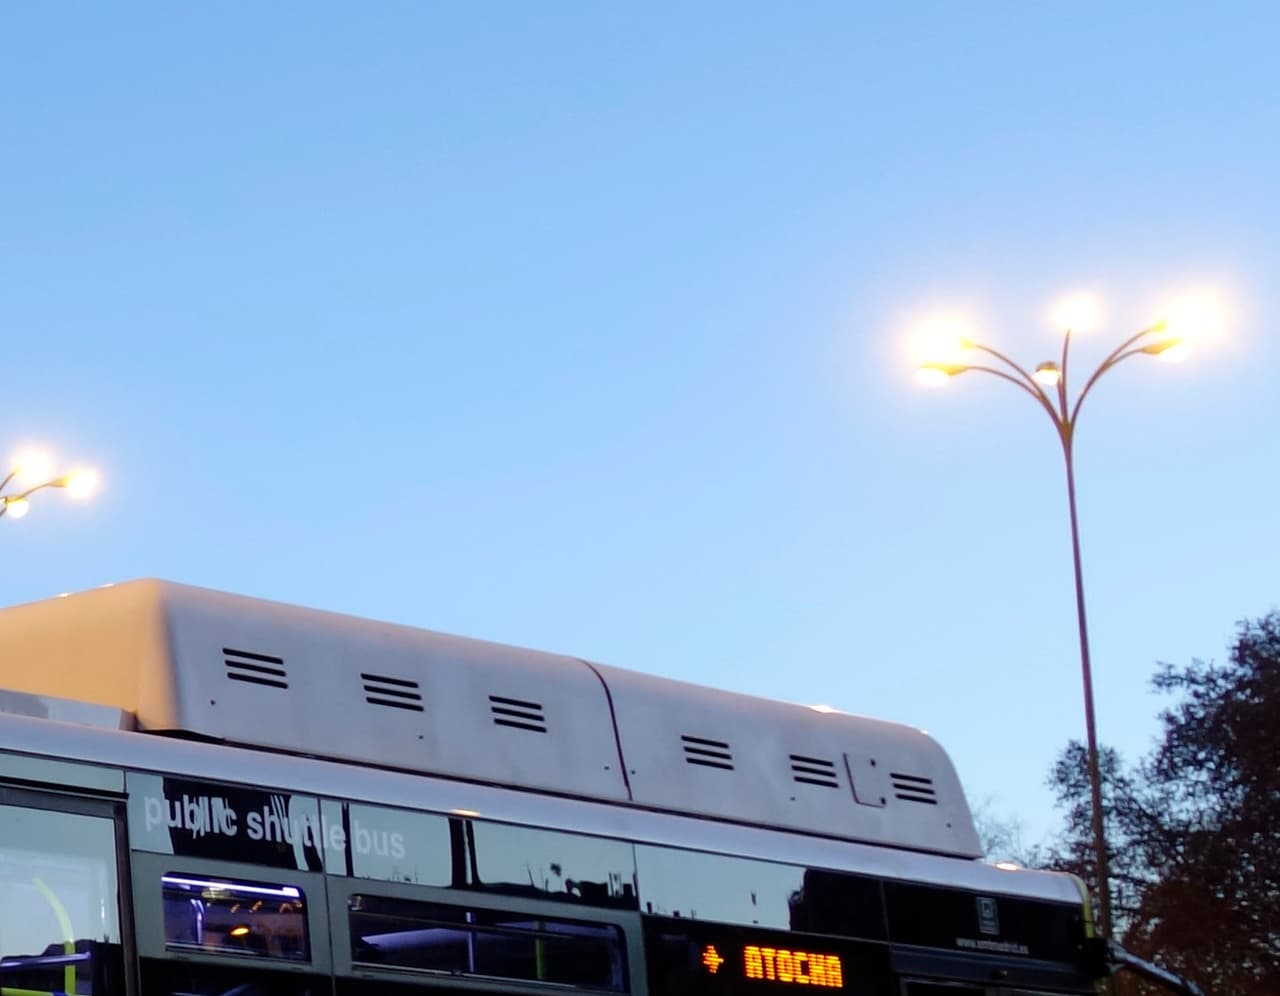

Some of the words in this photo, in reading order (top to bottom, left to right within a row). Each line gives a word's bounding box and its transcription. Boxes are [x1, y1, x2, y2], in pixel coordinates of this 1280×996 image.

[143, 793, 239, 838] public
[246, 804, 346, 849] shuttle
[353, 819, 406, 859] bus
[744, 945, 844, 988] ATOCHA
